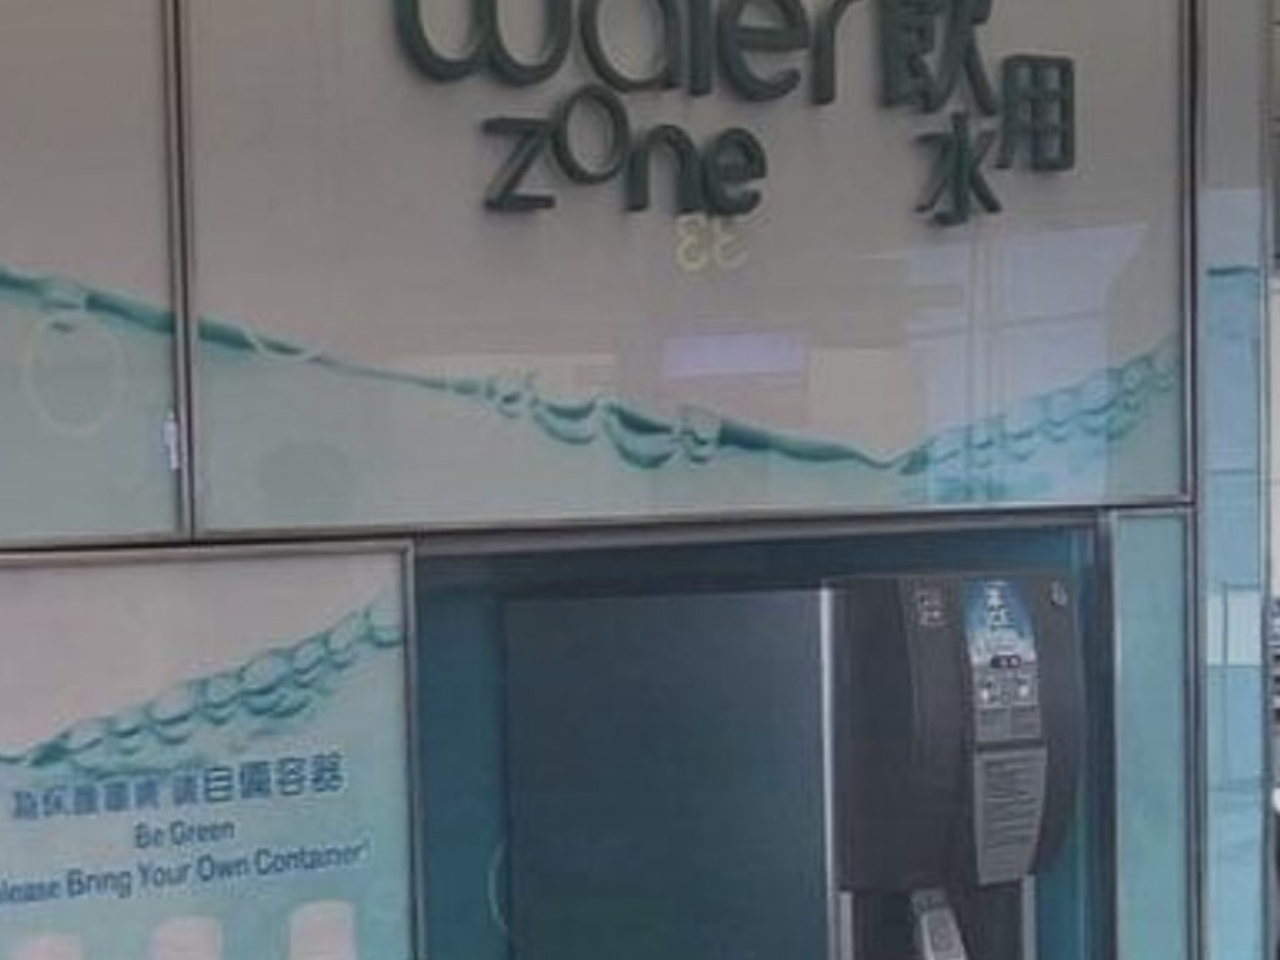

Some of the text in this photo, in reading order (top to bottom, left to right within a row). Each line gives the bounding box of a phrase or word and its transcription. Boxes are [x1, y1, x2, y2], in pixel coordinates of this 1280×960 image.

[134, 819, 236, 849] Be Green
[66, 868, 132, 898] Bring
[137, 861, 191, 889] Your
[197, 853, 250, 882] Own
